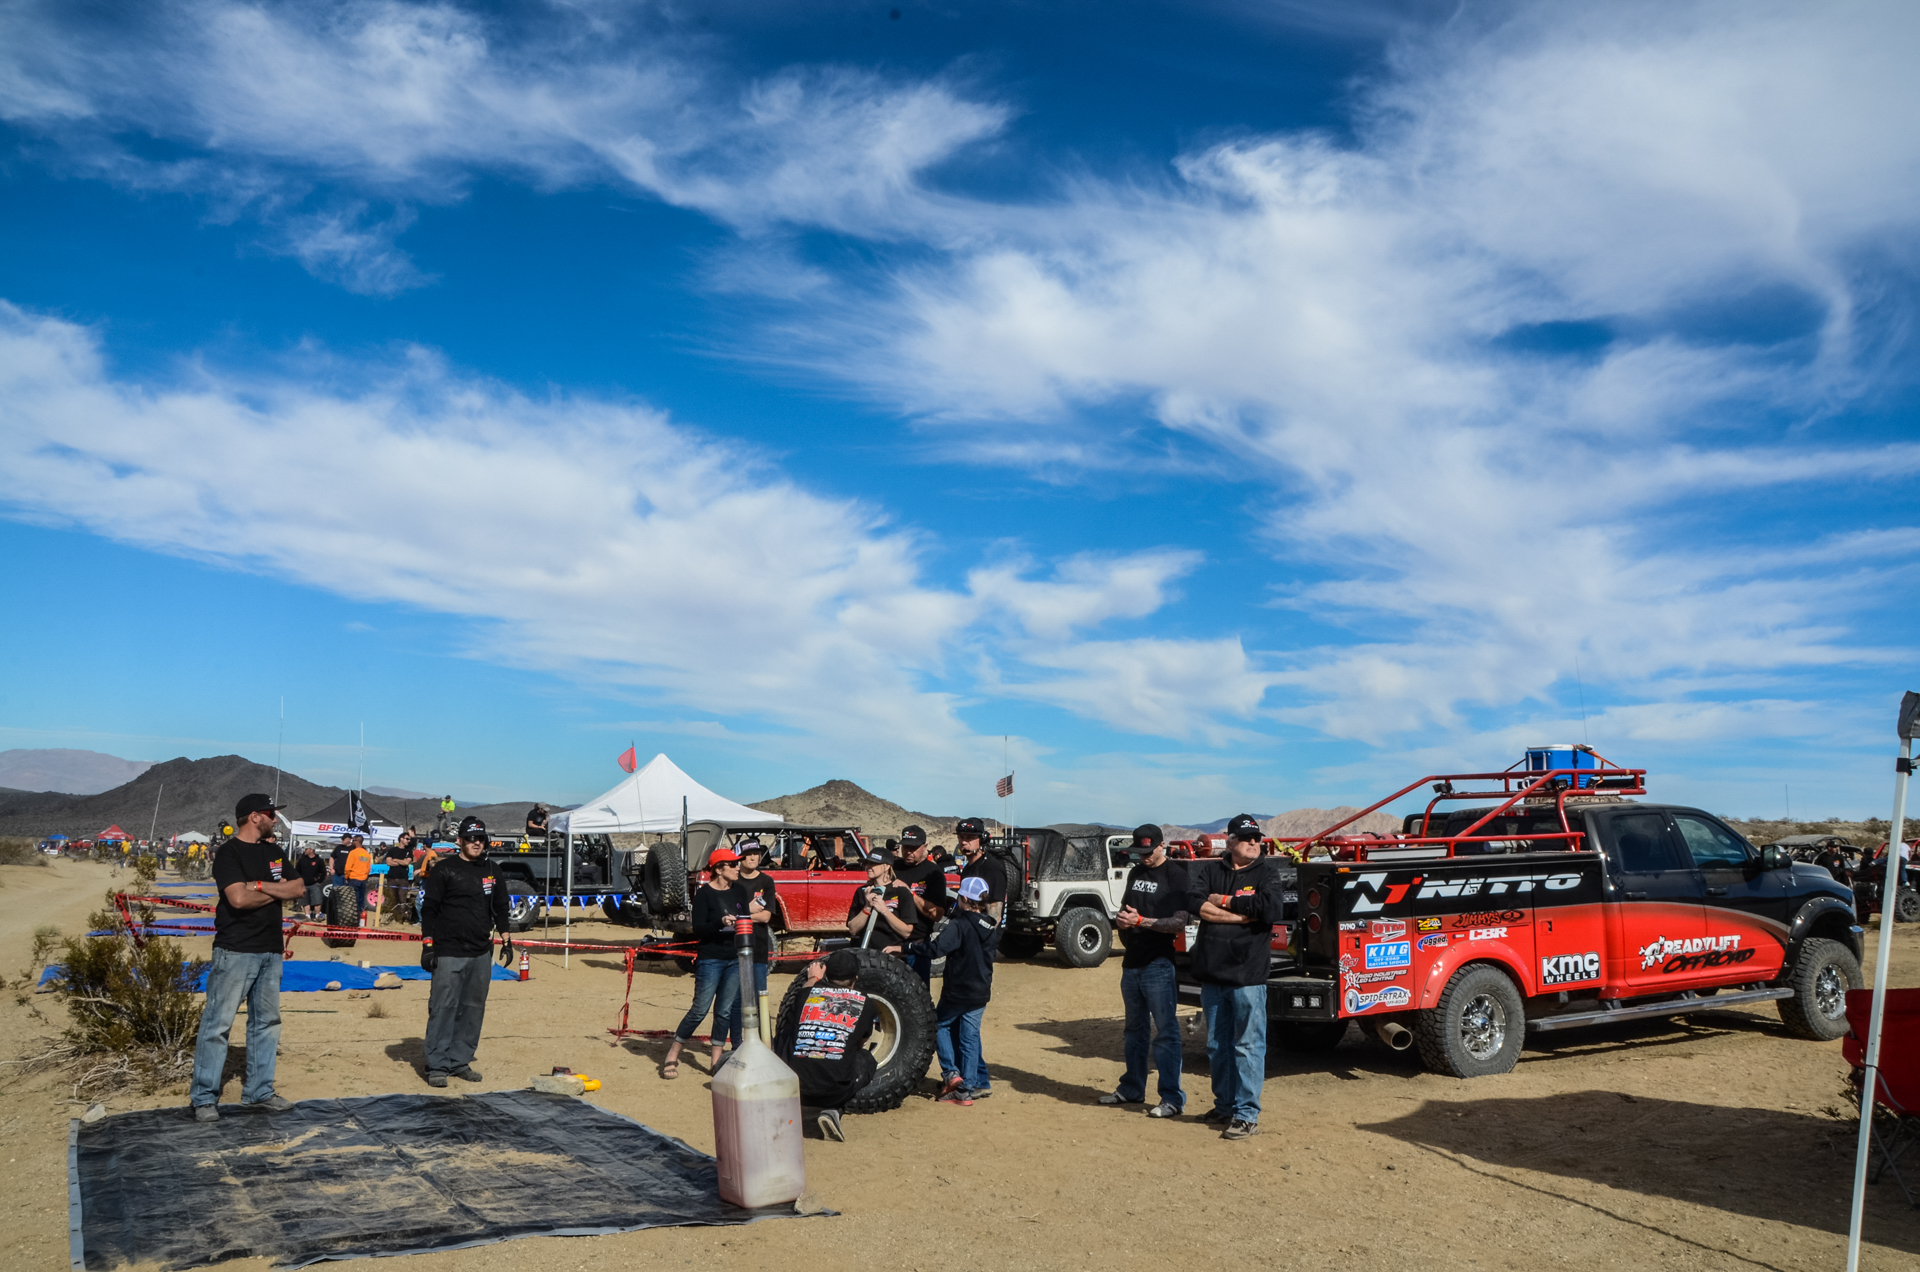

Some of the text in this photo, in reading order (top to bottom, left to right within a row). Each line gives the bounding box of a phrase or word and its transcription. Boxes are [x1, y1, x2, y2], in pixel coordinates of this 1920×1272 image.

[1416, 873, 1582, 899] NITTO
[1469, 927, 1508, 940] CBR
[1368, 944, 1408, 957] KING
[1663, 935, 1741, 955] READYLIFT
[1662, 948, 1755, 974] OFFROAD
[1545, 971, 1597, 983] WHEELS
[1360, 991, 1407, 1003] SPIDERTRAX
[800, 1005, 857, 1028] HEALY
